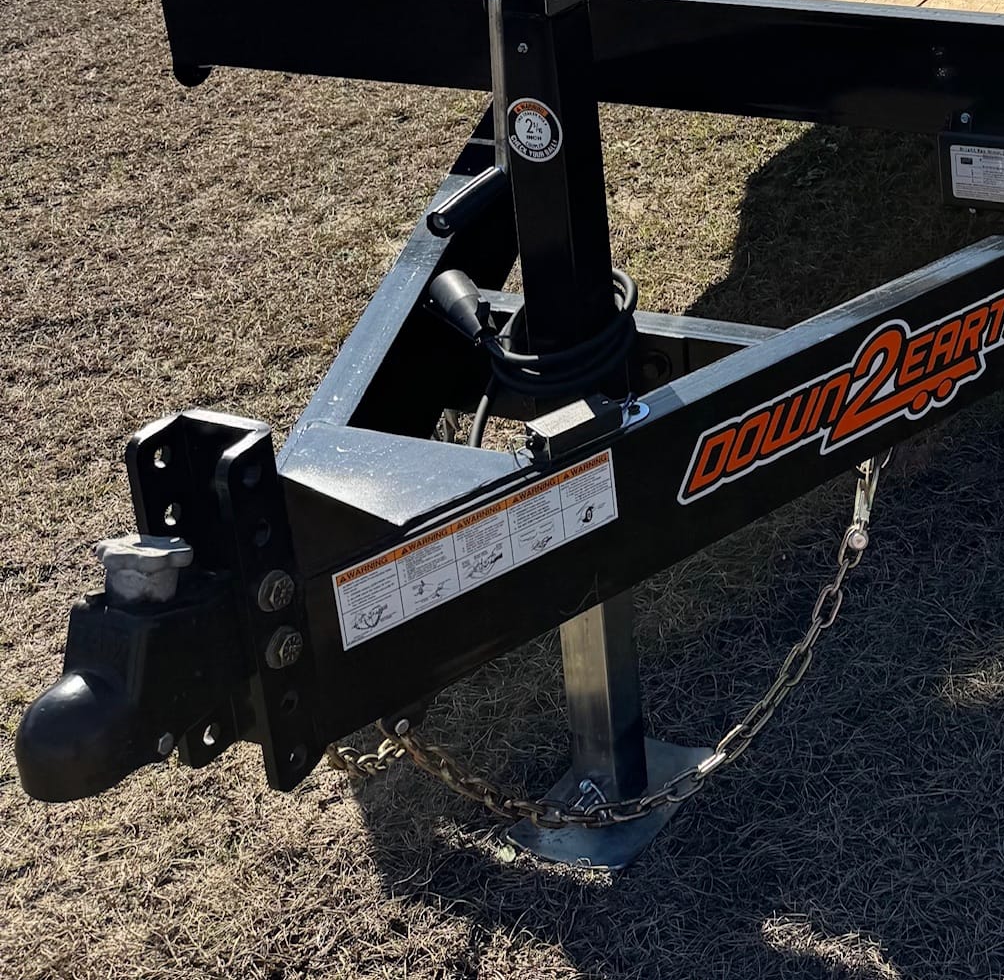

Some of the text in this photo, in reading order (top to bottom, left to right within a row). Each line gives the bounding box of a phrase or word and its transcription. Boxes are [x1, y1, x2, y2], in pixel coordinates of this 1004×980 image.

[571, 455, 608, 477] WARNING
[520, 478, 557, 502] WARNING
[463, 504, 502, 527] WARNING
[407, 529, 450, 552] WARNING
[345, 556, 389, 581] WARNING
